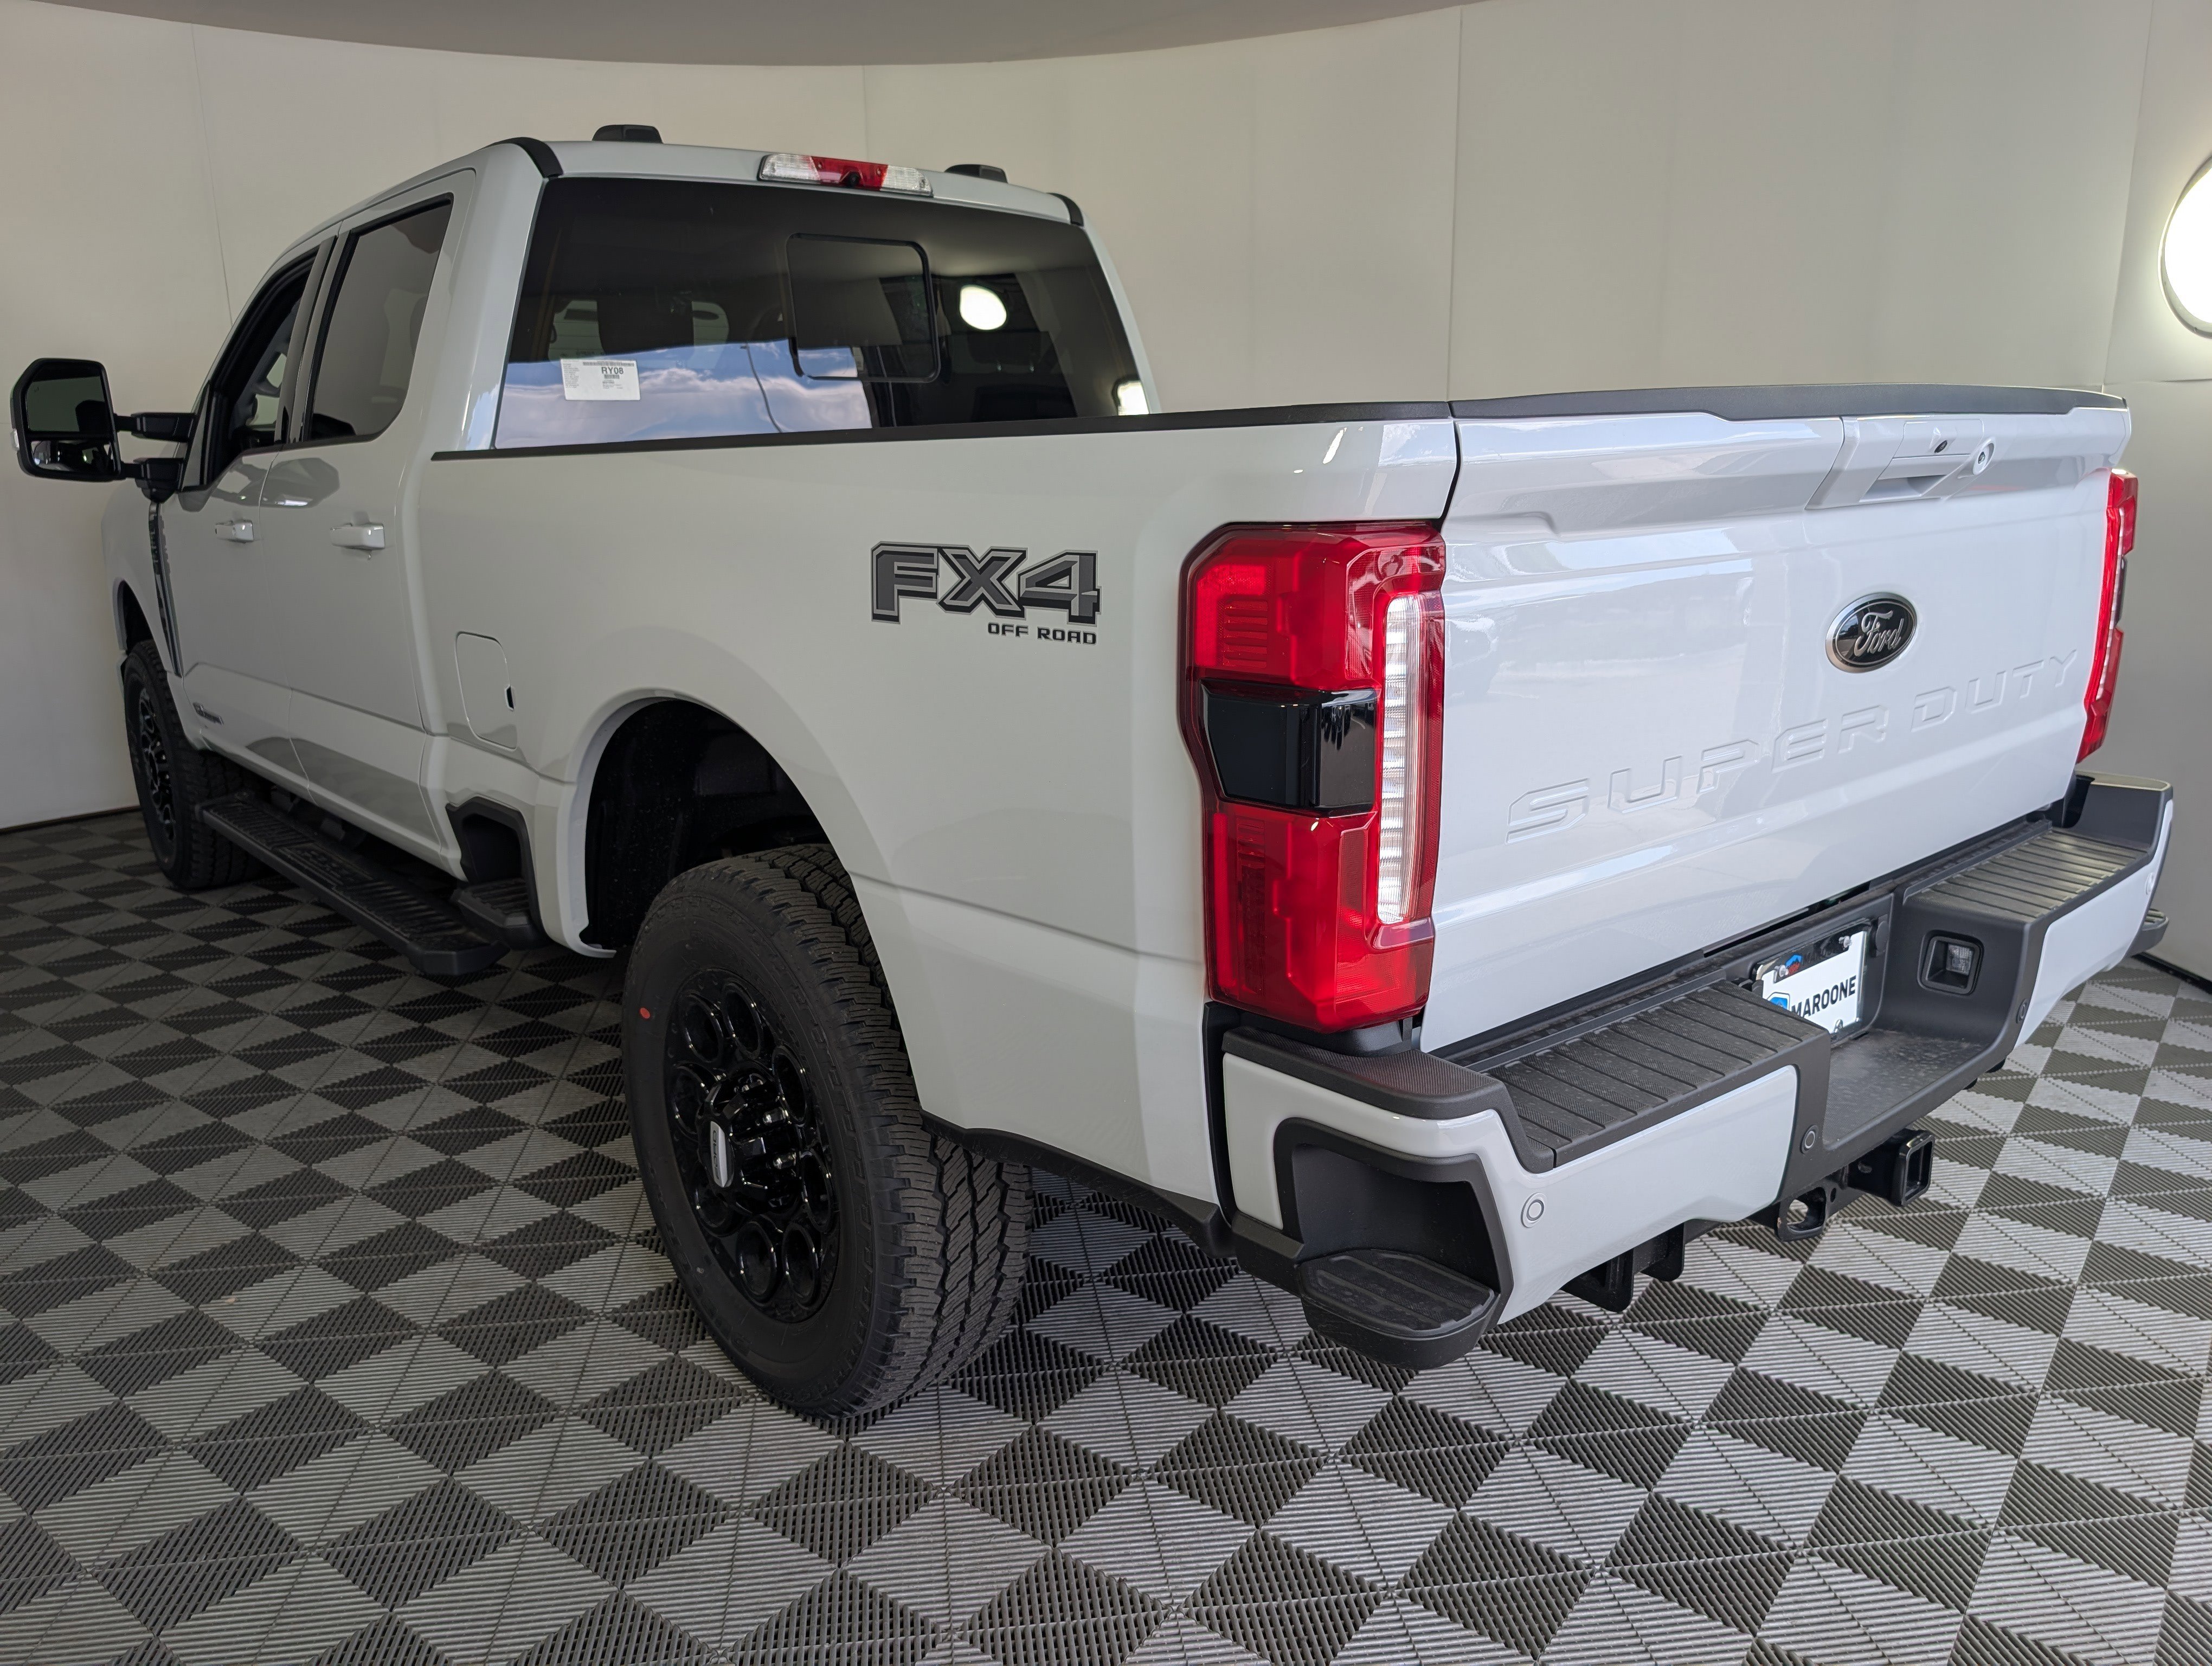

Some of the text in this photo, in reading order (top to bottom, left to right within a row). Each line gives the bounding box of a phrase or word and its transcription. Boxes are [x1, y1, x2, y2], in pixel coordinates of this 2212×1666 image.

[870, 541, 1102, 627] FX4
[987, 621, 1097, 645] OFF ROAD
[1854, 610, 1905, 657] Ford
[1504, 648, 2078, 845] SUPER DUTY
[1791, 975, 1857, 1017] MAROONE
